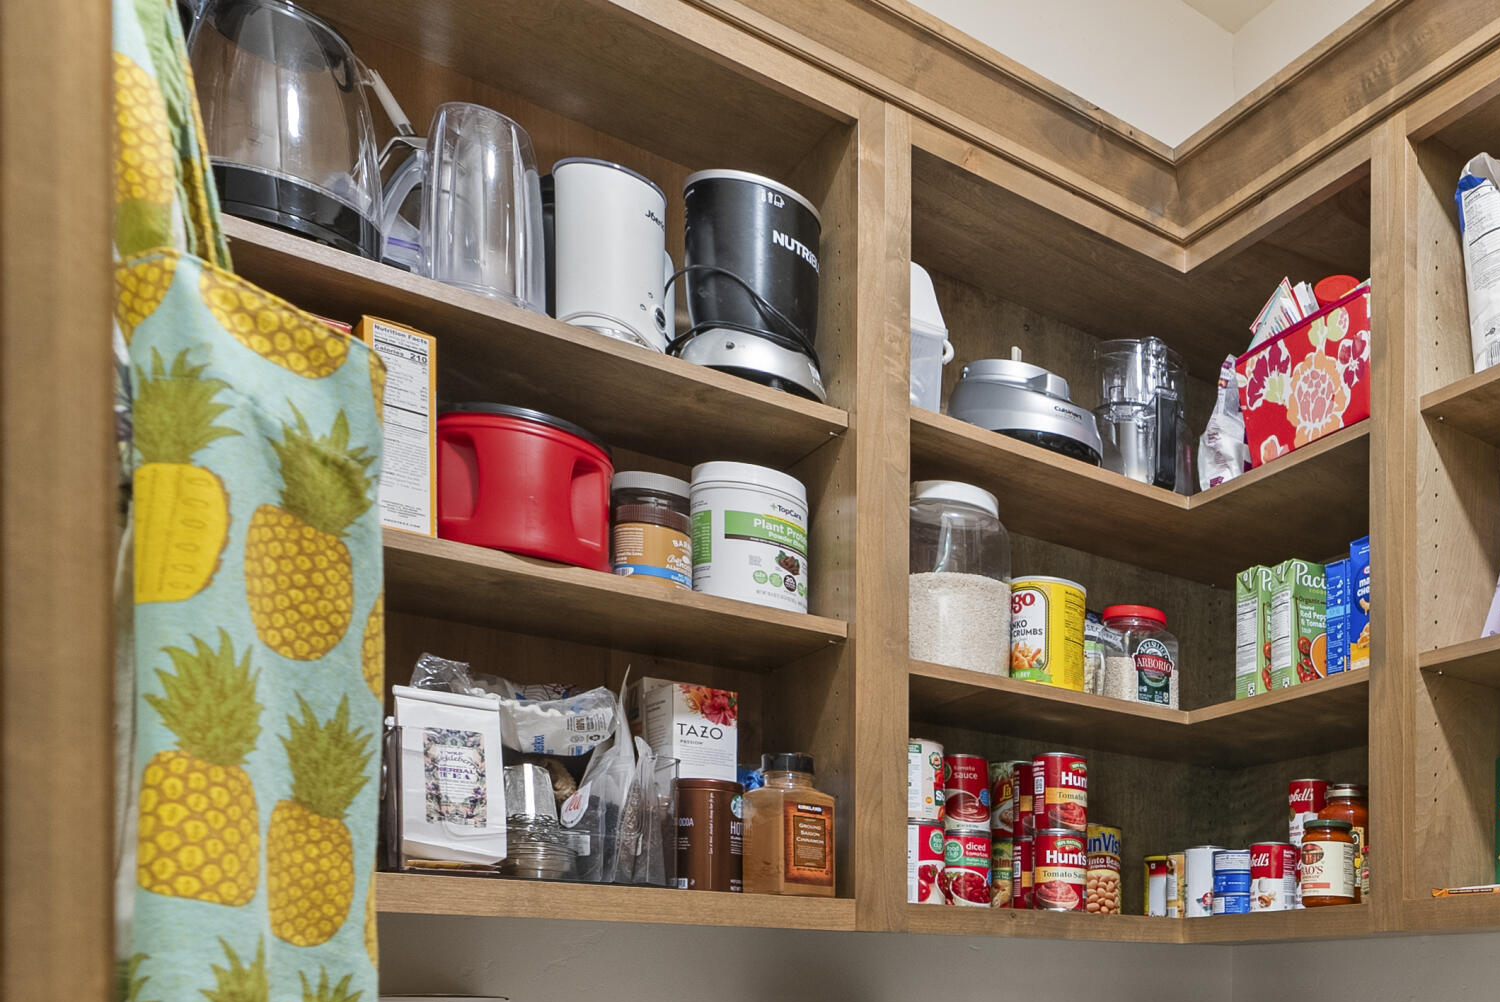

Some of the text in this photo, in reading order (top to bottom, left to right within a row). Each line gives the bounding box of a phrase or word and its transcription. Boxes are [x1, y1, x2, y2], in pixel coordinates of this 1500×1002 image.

[374, 343, 428, 364] Calories 210
[753, 518, 784, 535] Plant
[1300, 610, 1312, 620] Red
[1136, 658, 1172, 672] ARBORIO
[677, 722, 724, 740] TAZO
[953, 772, 978, 780] sauce
[1057, 790, 1082, 801] Tomato
[798, 823, 822, 831] GROUND
[796, 836, 825, 845] CINNAMON
[965, 842, 986, 851] diced
[1046, 849, 1087, 867] Hunt's
[1042, 869, 1069, 879] Tomato
